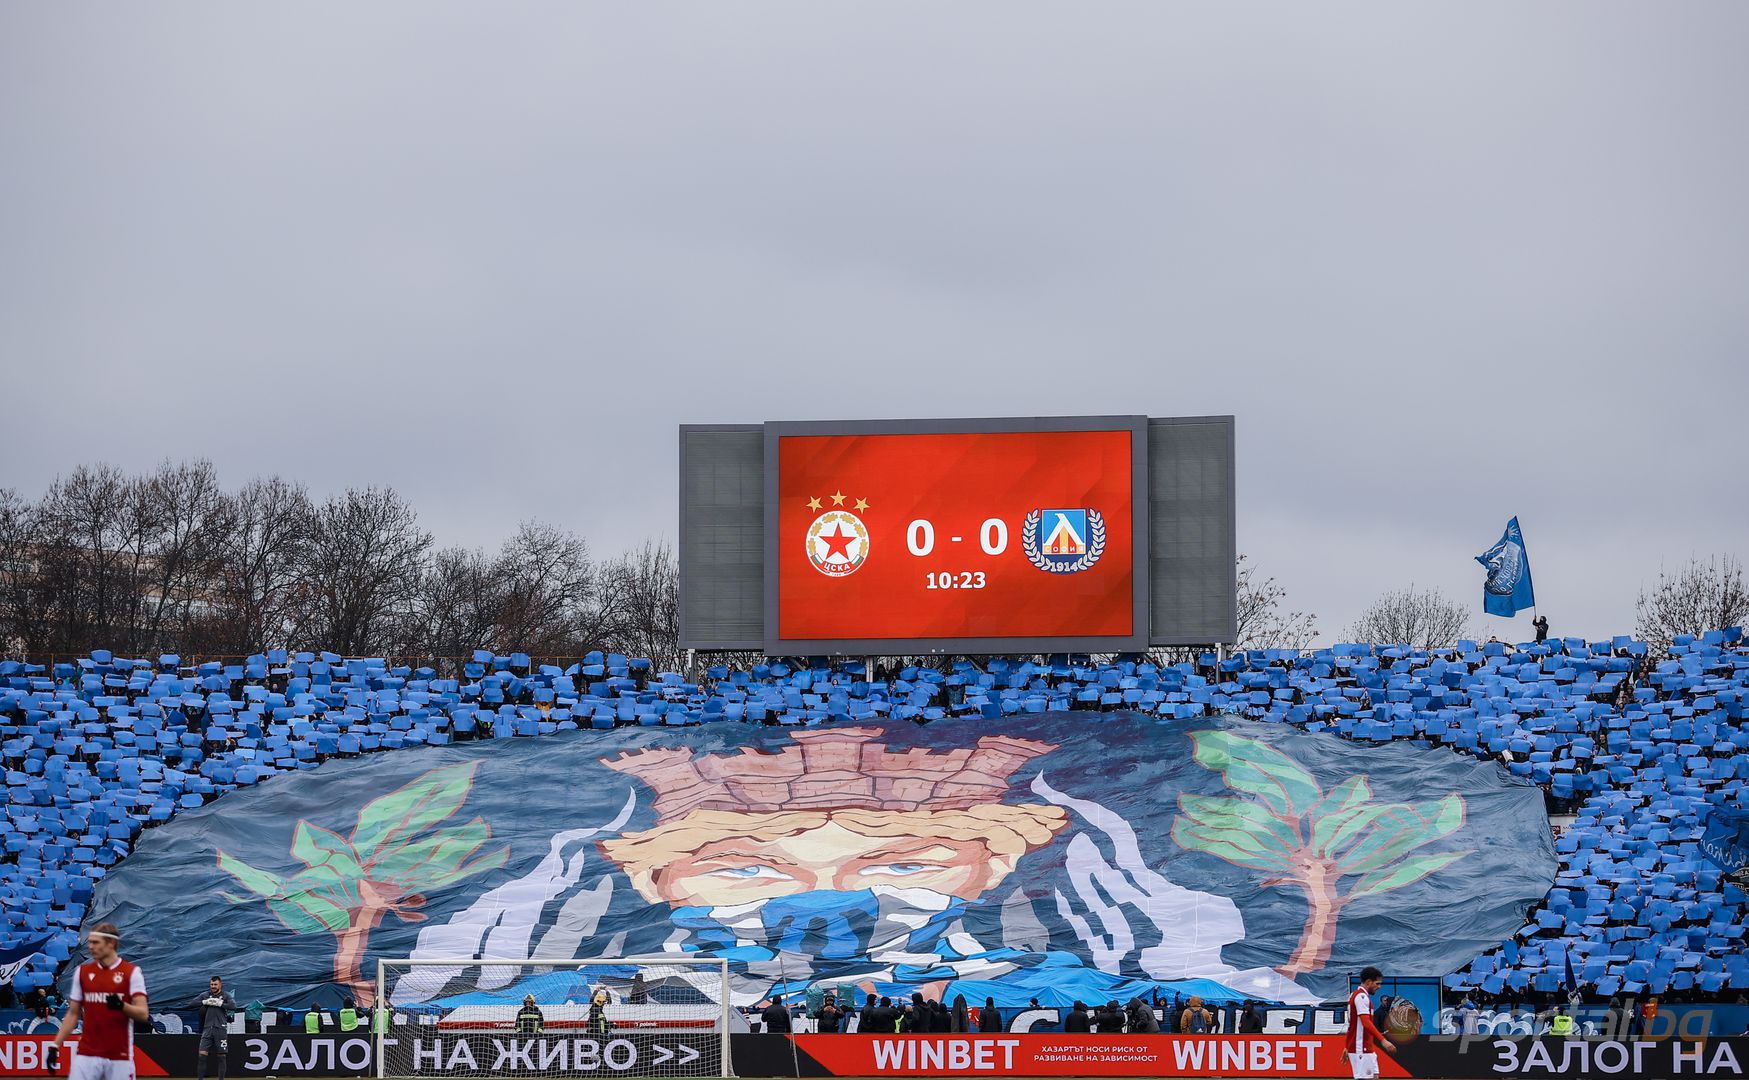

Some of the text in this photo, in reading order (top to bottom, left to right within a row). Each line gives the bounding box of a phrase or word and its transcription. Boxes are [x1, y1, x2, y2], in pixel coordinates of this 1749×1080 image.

[906, 519, 935, 557] 0
[979, 518, 1008, 556] 0
[824, 562, 851, 573] ЦСКА
[1050, 561, 1079, 572] 1914
[926, 571, 987, 590] 10:23
[84, 991, 126, 1004] WINBT
[413, 1038, 479, 1070] НА
[491, 1038, 638, 1071] ЖИВО
[872, 1039, 1020, 1070] WINBET
[1034, 1054, 1158, 1062] РАЗВИВАНЕ НА ЗАВИСИМОСТ
[1172, 1040, 1322, 1071] WINBET
[1492, 1039, 1743, 1073] ЗАЛОГ НА
